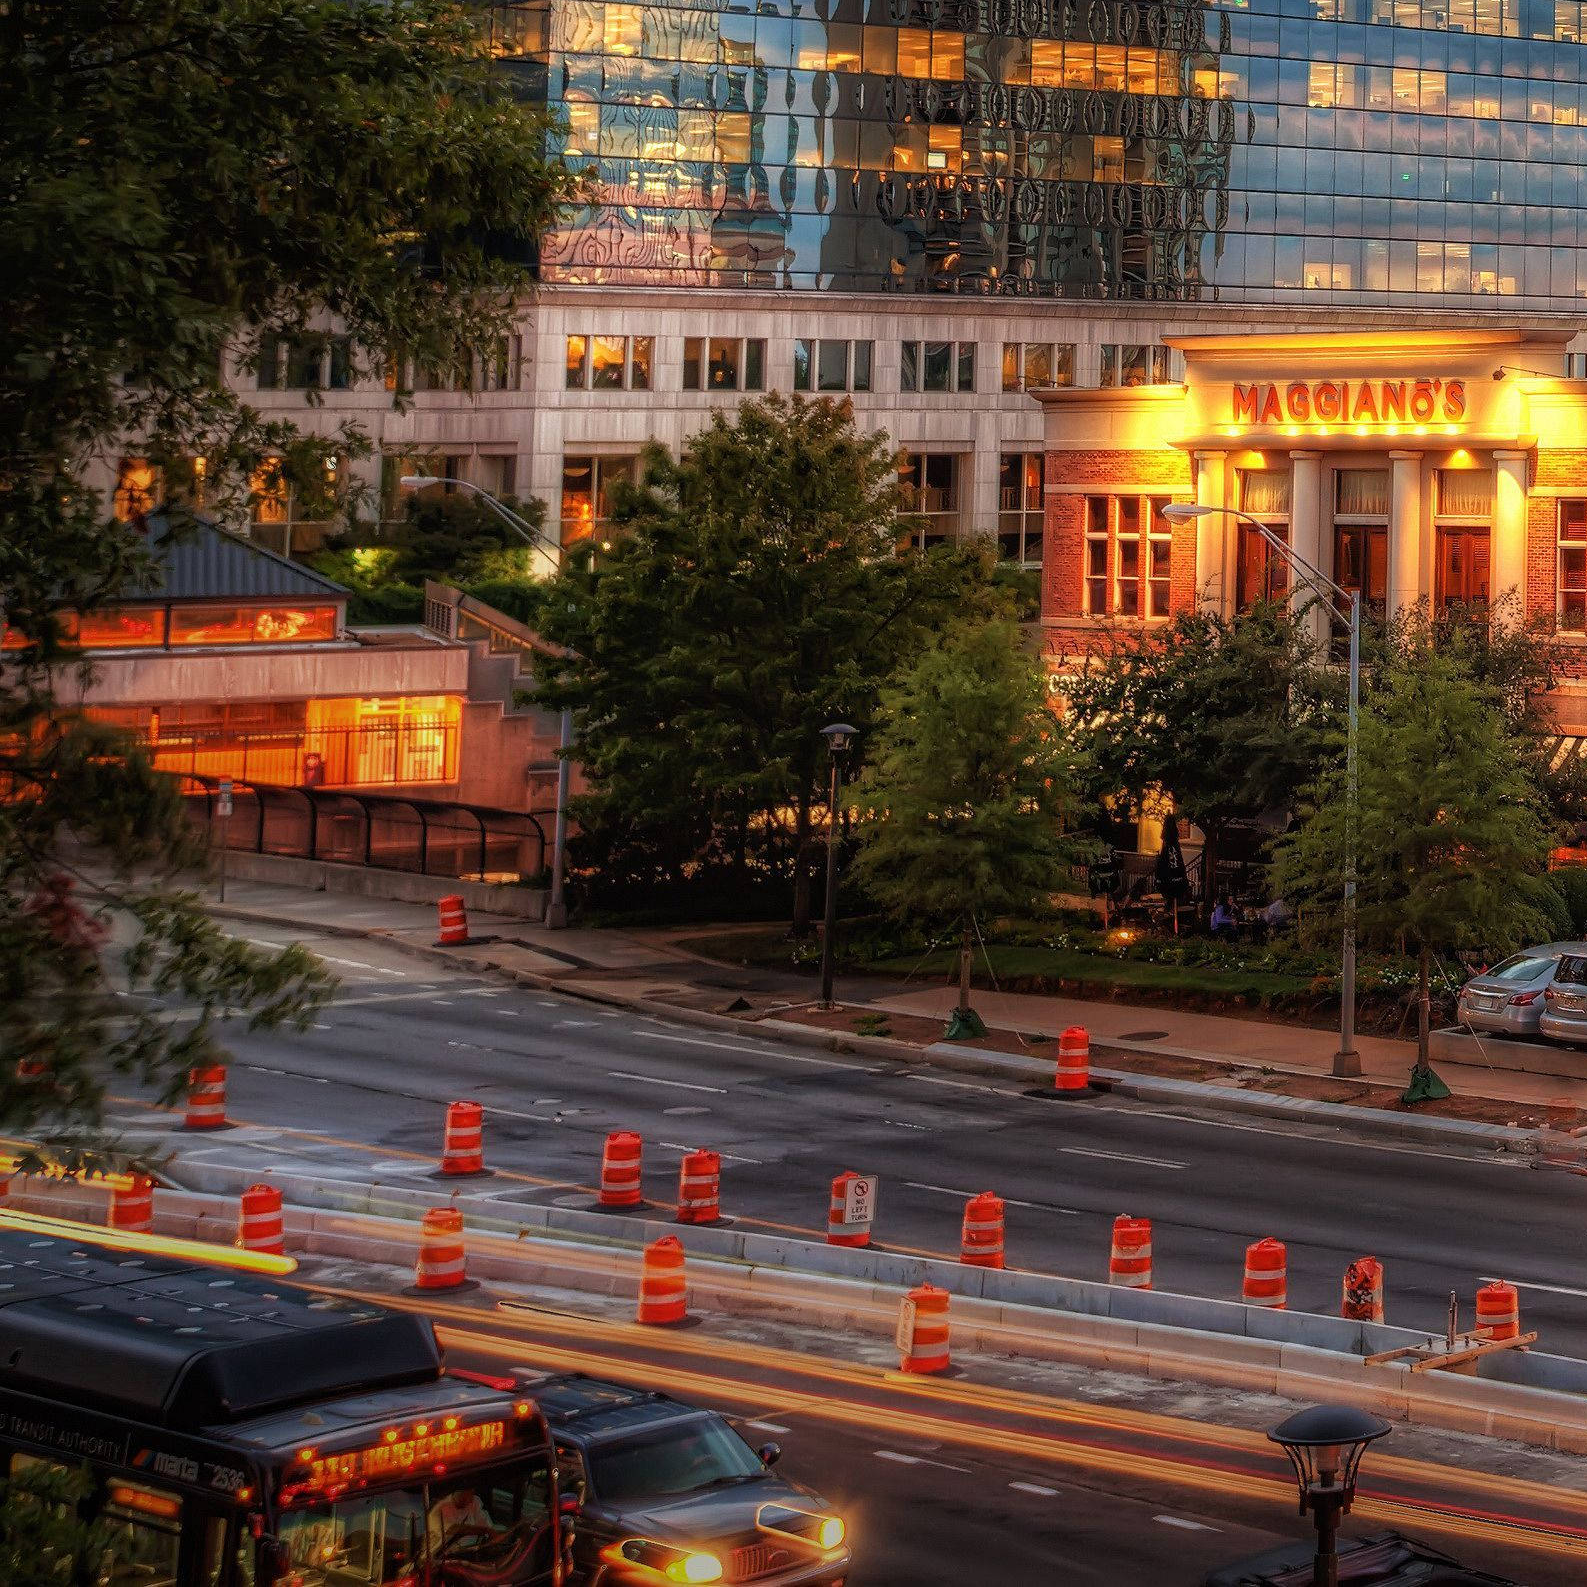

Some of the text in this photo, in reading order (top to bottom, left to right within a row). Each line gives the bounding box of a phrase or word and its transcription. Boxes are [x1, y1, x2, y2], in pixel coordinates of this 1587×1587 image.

[1232, 378, 1466, 422] MAGGIANO'S
[10, 1415, 54, 1444] TRANSIT
[57, 1429, 121, 1463] AUTHORITY
[154, 1452, 199, 1482] marta
